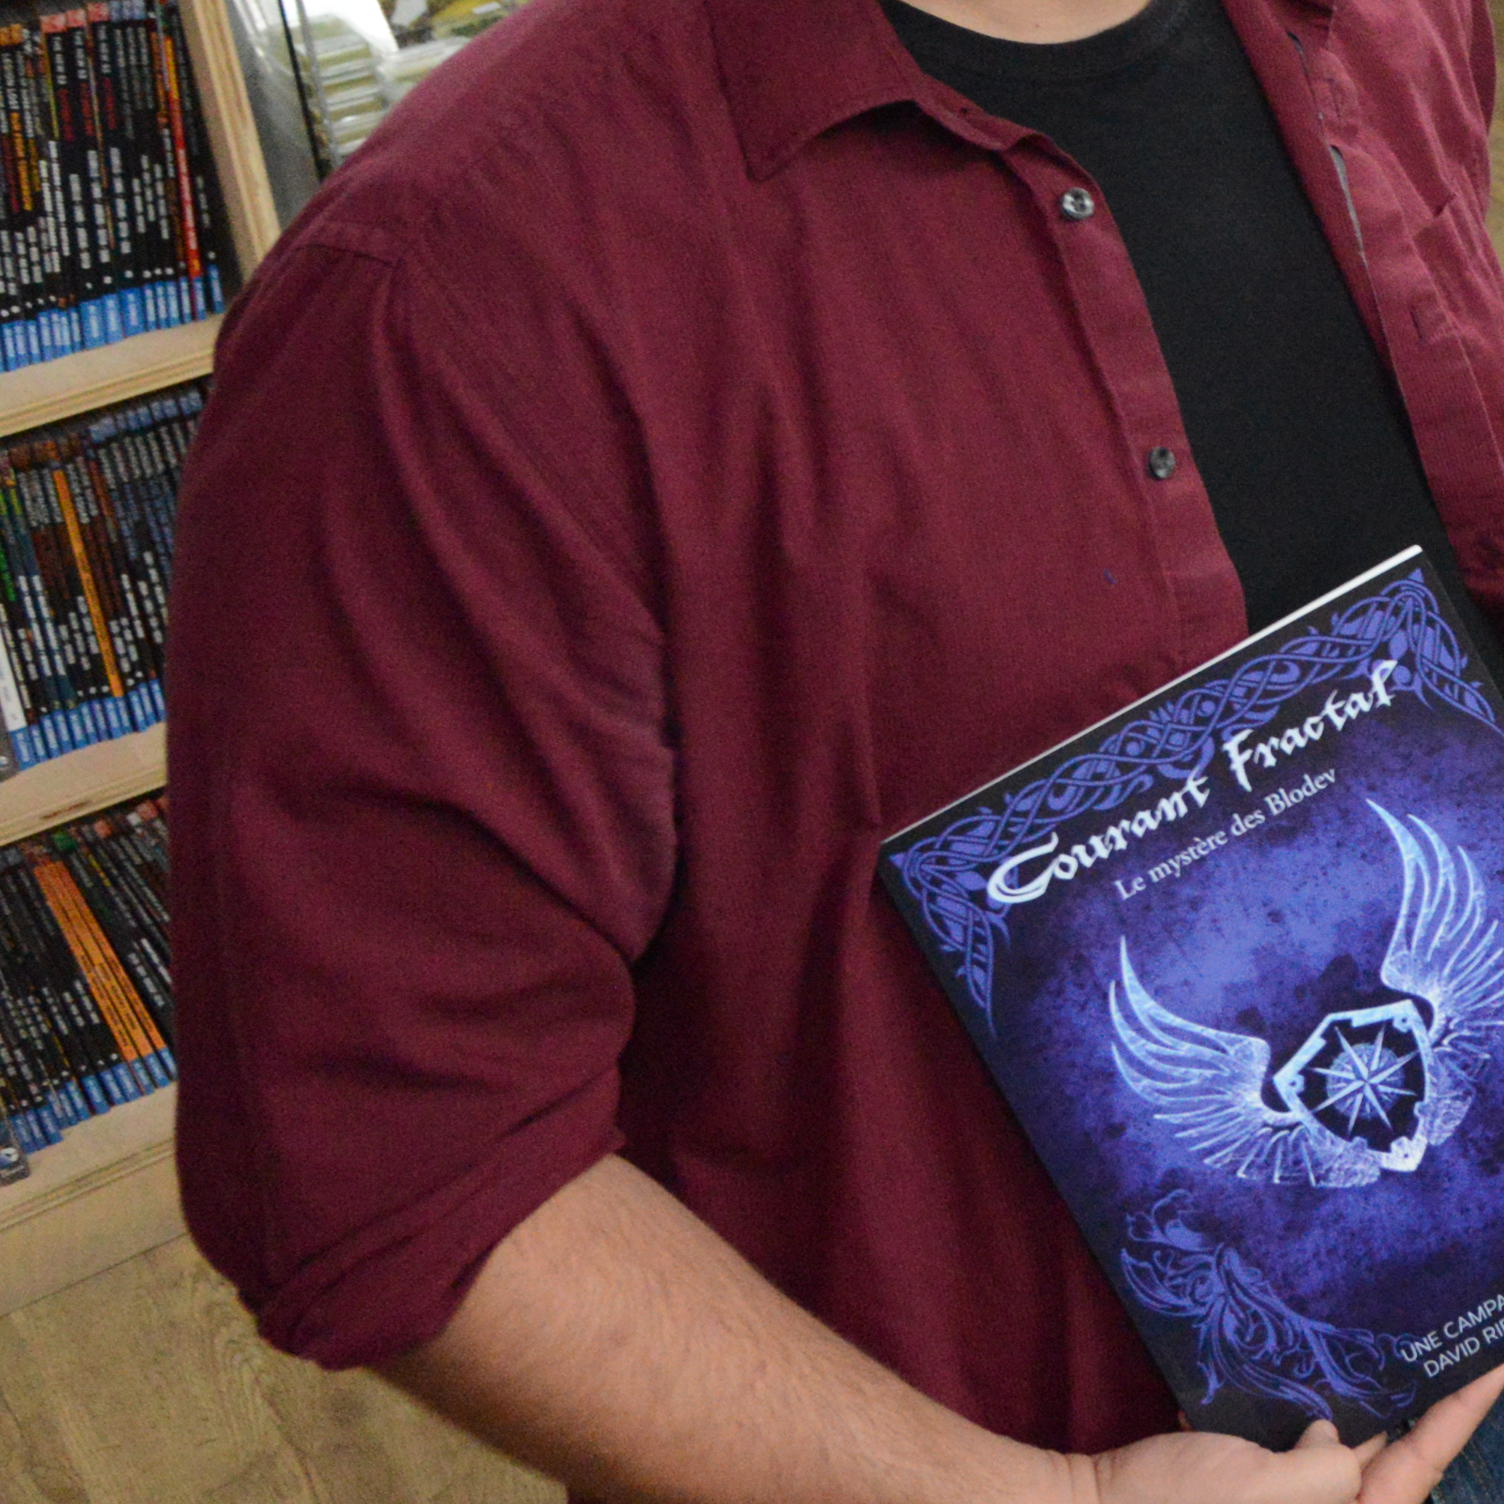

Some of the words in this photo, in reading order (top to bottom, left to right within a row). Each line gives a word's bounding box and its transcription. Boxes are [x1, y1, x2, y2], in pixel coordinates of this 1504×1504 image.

[986, 764, 1211, 905] Courant
[1221, 658, 1399, 793] Fractal
[1113, 873, 1145, 901] Le
[1147, 825, 1230, 883] mystère
[1230, 806, 1266, 838] des
[1265, 765, 1339, 818] Blodev
[1400, 1329, 1444, 1363] UNE
[1422, 1335, 1482, 1379] DAVID
